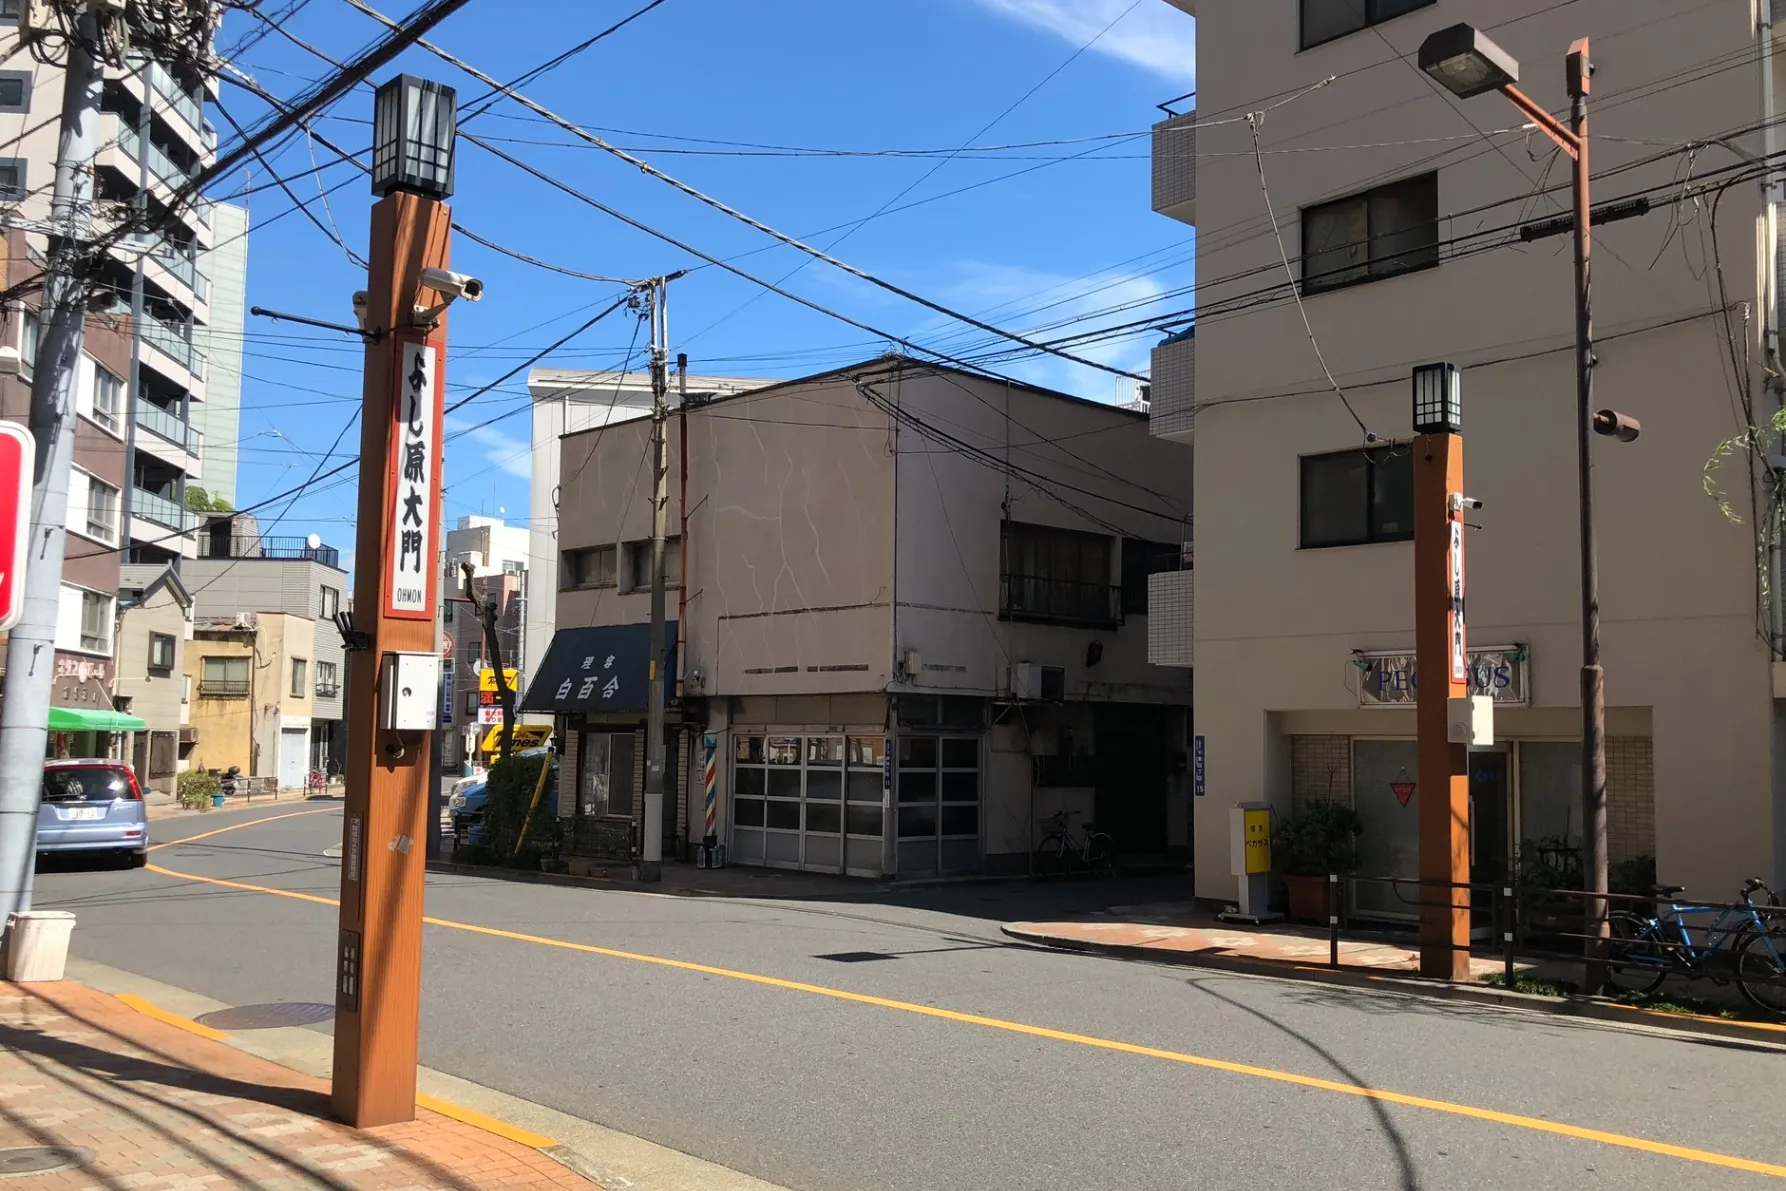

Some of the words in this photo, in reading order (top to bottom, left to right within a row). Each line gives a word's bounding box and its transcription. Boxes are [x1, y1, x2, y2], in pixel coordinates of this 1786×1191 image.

[401, 352, 427, 573] よし原大門
[397, 588, 422, 603] OHMON
[555, 675, 619, 700] 白百合
[1380, 666, 1510, 691] PEUS
[1246, 839, 1269, 848] ペガサス
